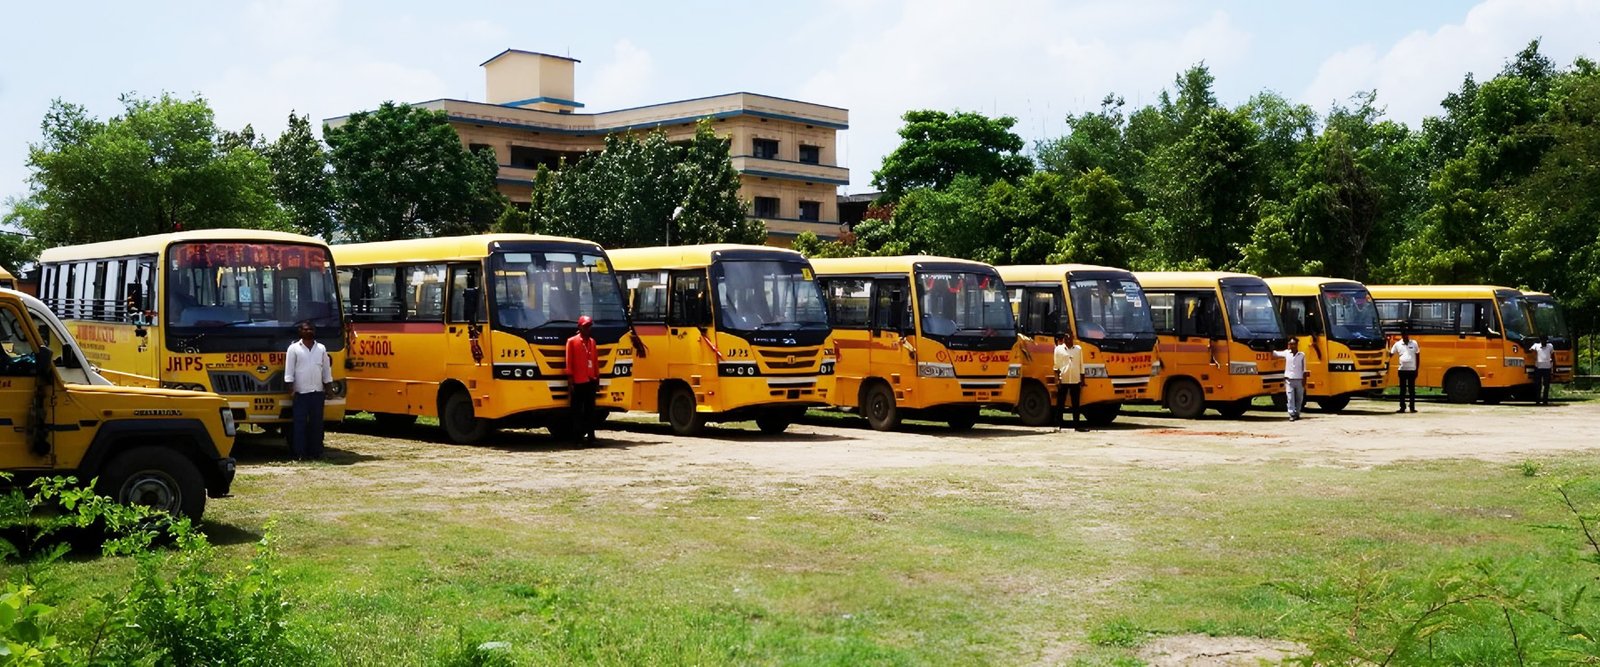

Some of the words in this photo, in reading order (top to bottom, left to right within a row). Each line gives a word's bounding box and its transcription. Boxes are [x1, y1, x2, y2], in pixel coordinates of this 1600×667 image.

[165, 356, 204, 372] JHPS
[226, 353, 265, 363] SCHOOL
[269, 353, 285, 364] BU
